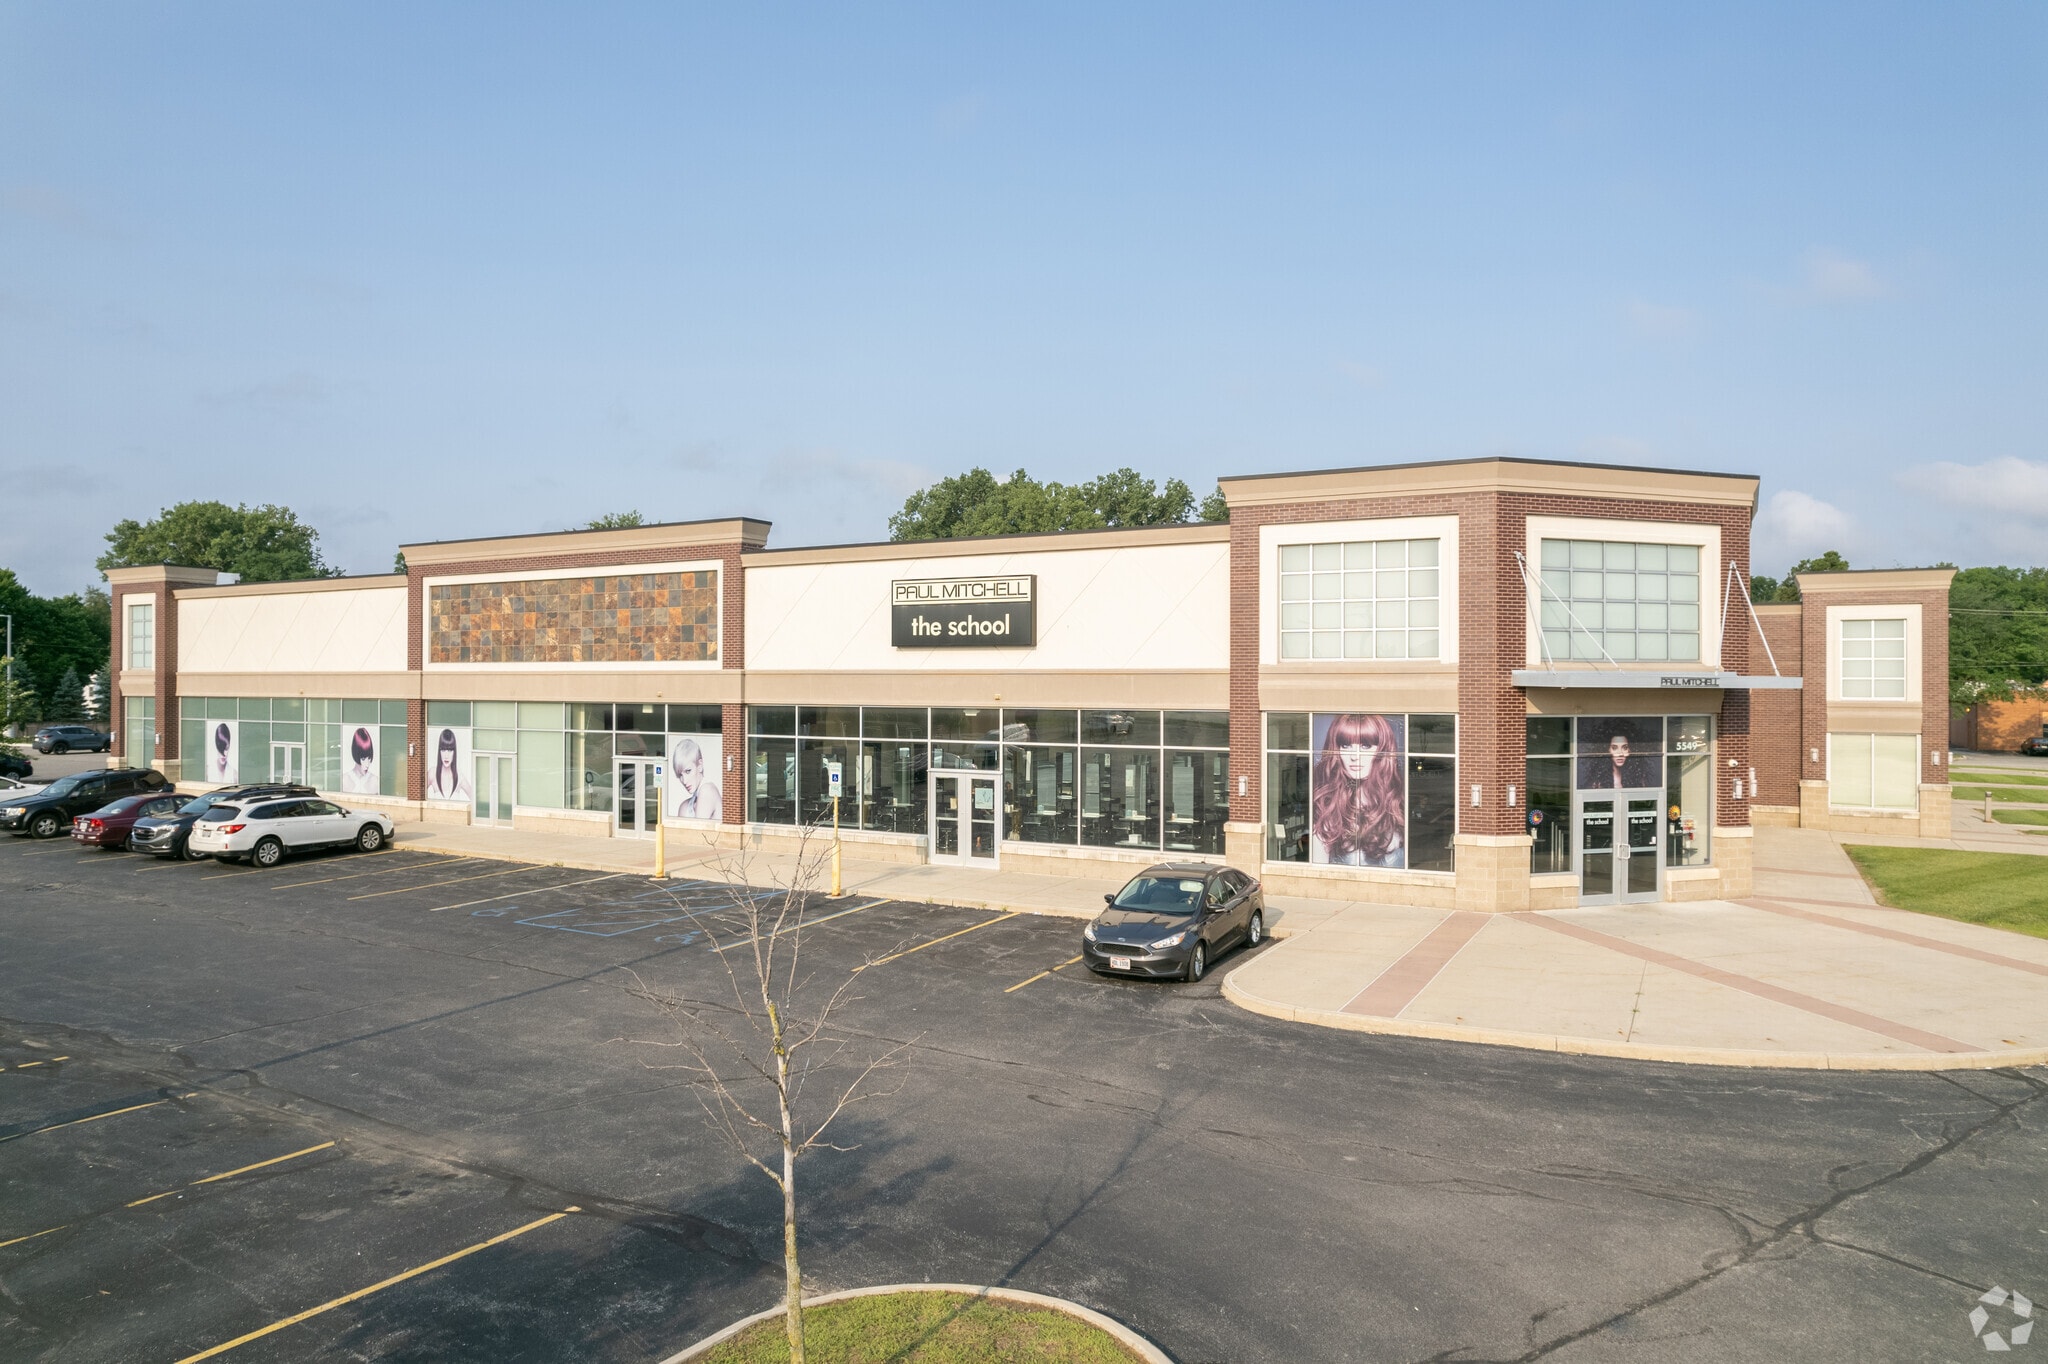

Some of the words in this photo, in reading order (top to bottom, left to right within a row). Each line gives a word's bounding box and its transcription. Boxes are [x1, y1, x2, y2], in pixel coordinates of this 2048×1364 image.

[895, 585, 939, 600] PAUL
[942, 581, 1028, 598] MITCHELL
[911, 615, 942, 636] the
[948, 613, 1010, 636] school
[1660, 678, 1681, 686] PAUL
[1682, 678, 1720, 686] MITCHELL
[1676, 742, 1698, 750] 5549
